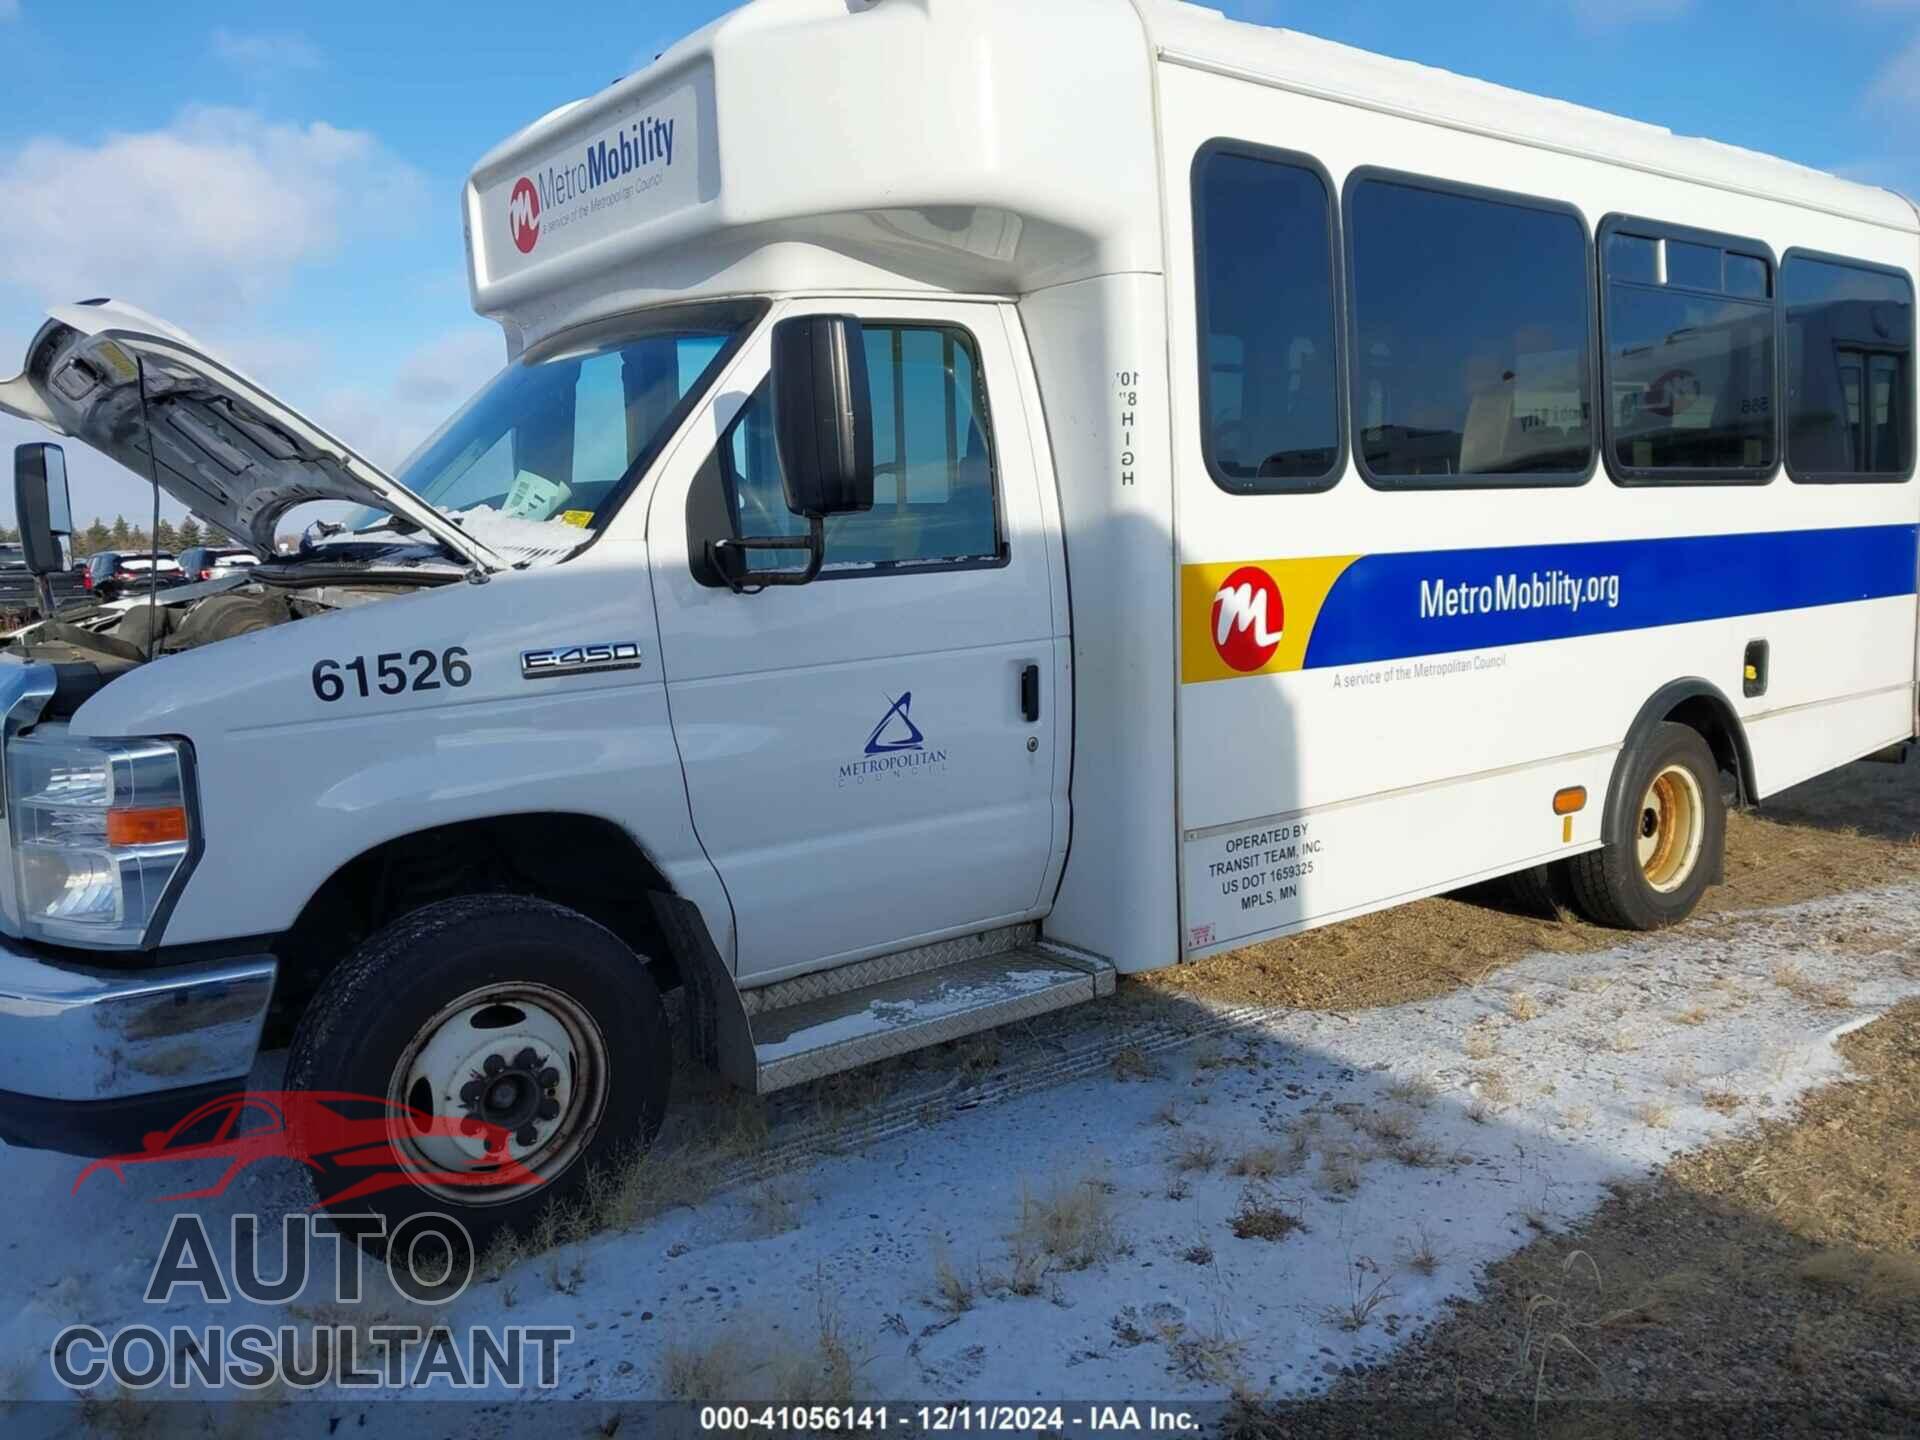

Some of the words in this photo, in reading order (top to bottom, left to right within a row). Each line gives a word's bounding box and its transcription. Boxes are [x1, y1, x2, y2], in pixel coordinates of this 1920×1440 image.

[538, 116, 674, 213] MetroMobility
[1420, 570, 1619, 619] MetroMobility.org
[311, 646, 472, 702] 61526
[1333, 674, 1341, 688] A
[1344, 671, 1381, 688] service
[1384, 667, 1394, 682] of
[1396, 667, 1411, 680] the
[1414, 658, 1472, 678] Metropolitan
[1473, 653, 1506, 670] Council
[839, 750, 948, 778] METROPOLITAN
[1226, 827, 1290, 853] OPERATED
[1293, 823, 1310, 838] BY
[1209, 854, 1260, 877] TRANSIT
[1302, 839, 1324, 856] INC.
[1222, 879, 1239, 895] US
[1242, 872, 1266, 890] DOT
[1270, 861, 1314, 883] 1659325
[1280, 884, 1297, 900] MN
